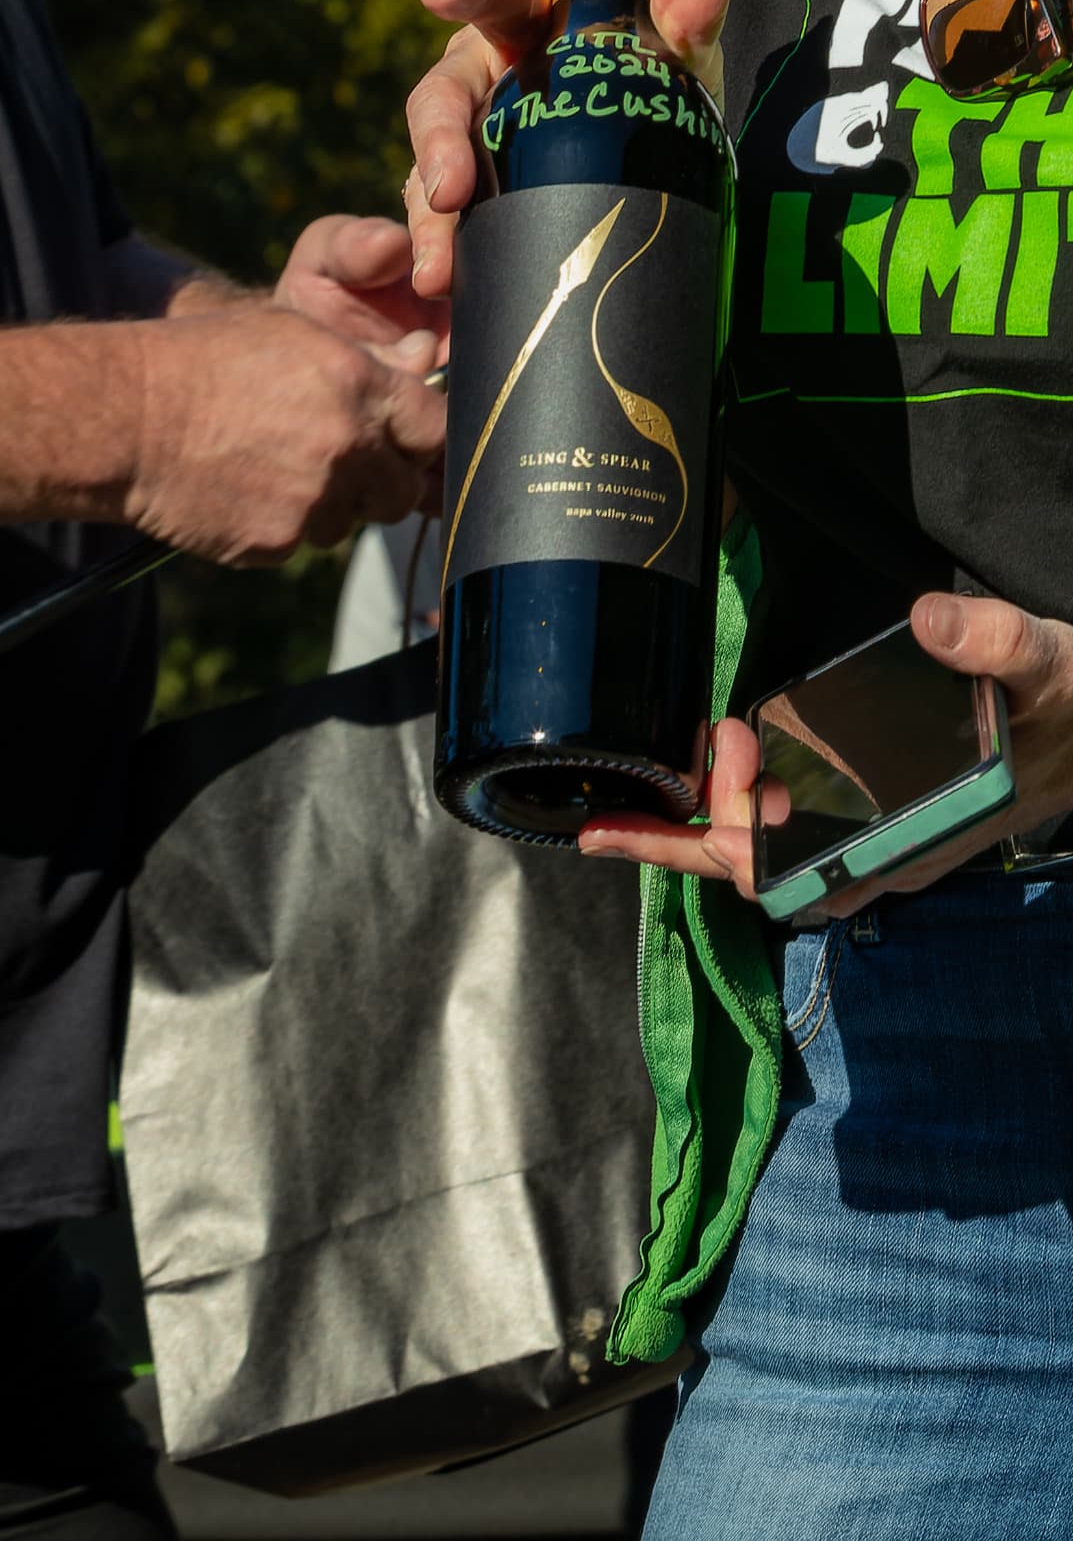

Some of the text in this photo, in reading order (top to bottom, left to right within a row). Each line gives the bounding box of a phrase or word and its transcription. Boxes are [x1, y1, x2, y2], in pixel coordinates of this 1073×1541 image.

[558, 54, 671, 88] 2024
[512, 90, 581, 130] The
[519, 446, 651, 472] SLING & SPEAR
[527, 482, 666, 503] CABERNET SAUVIGNON
[565, 507, 592, 519] napa
[595, 508, 628, 522] valley
